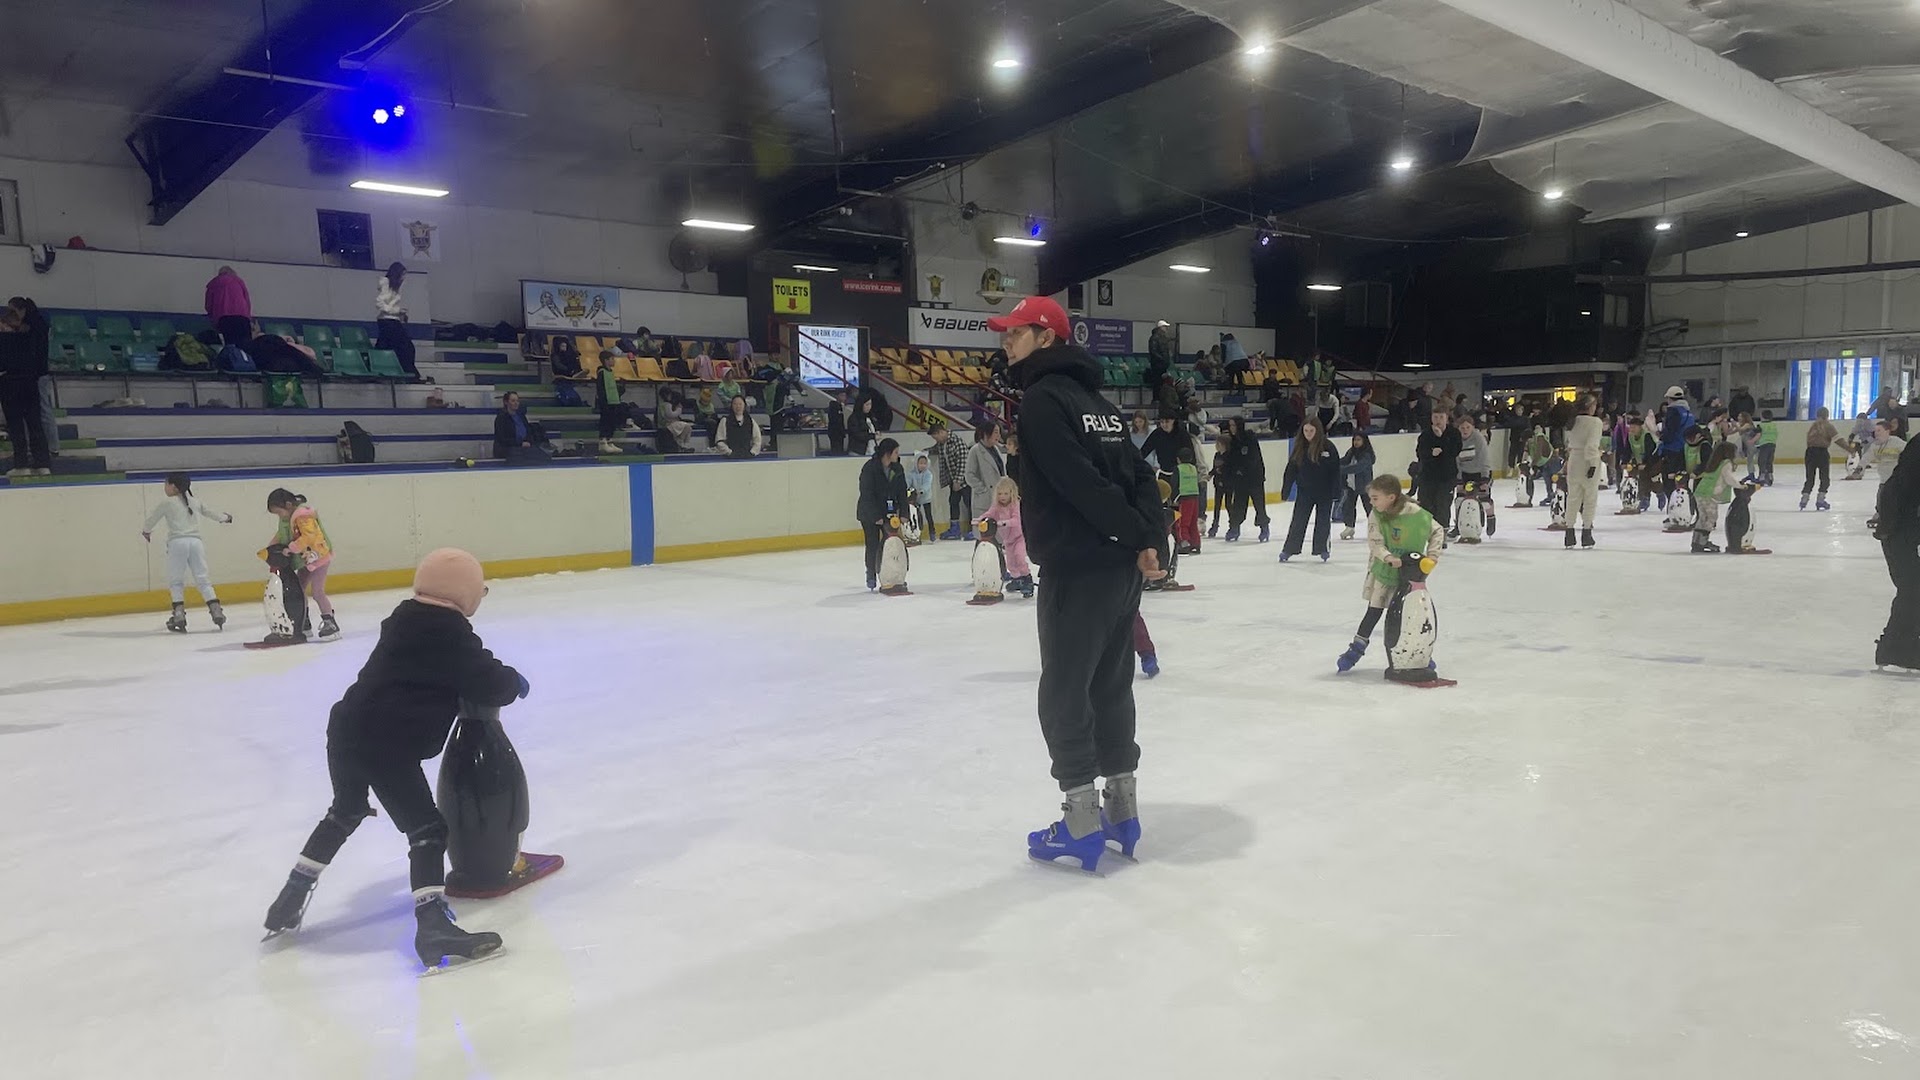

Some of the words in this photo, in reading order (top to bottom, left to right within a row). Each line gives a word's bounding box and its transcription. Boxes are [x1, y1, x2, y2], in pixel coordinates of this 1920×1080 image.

[844, 282, 901, 293] www.icerink.com.au
[1002, 277, 1016, 287] EXIT
[557, 288, 588, 299] KONDOS
[775, 285, 809, 297] TOILETS
[934, 318, 988, 332] BAUER
[820, 329, 831, 337] RINK
[911, 404, 945, 426] TOLETS
